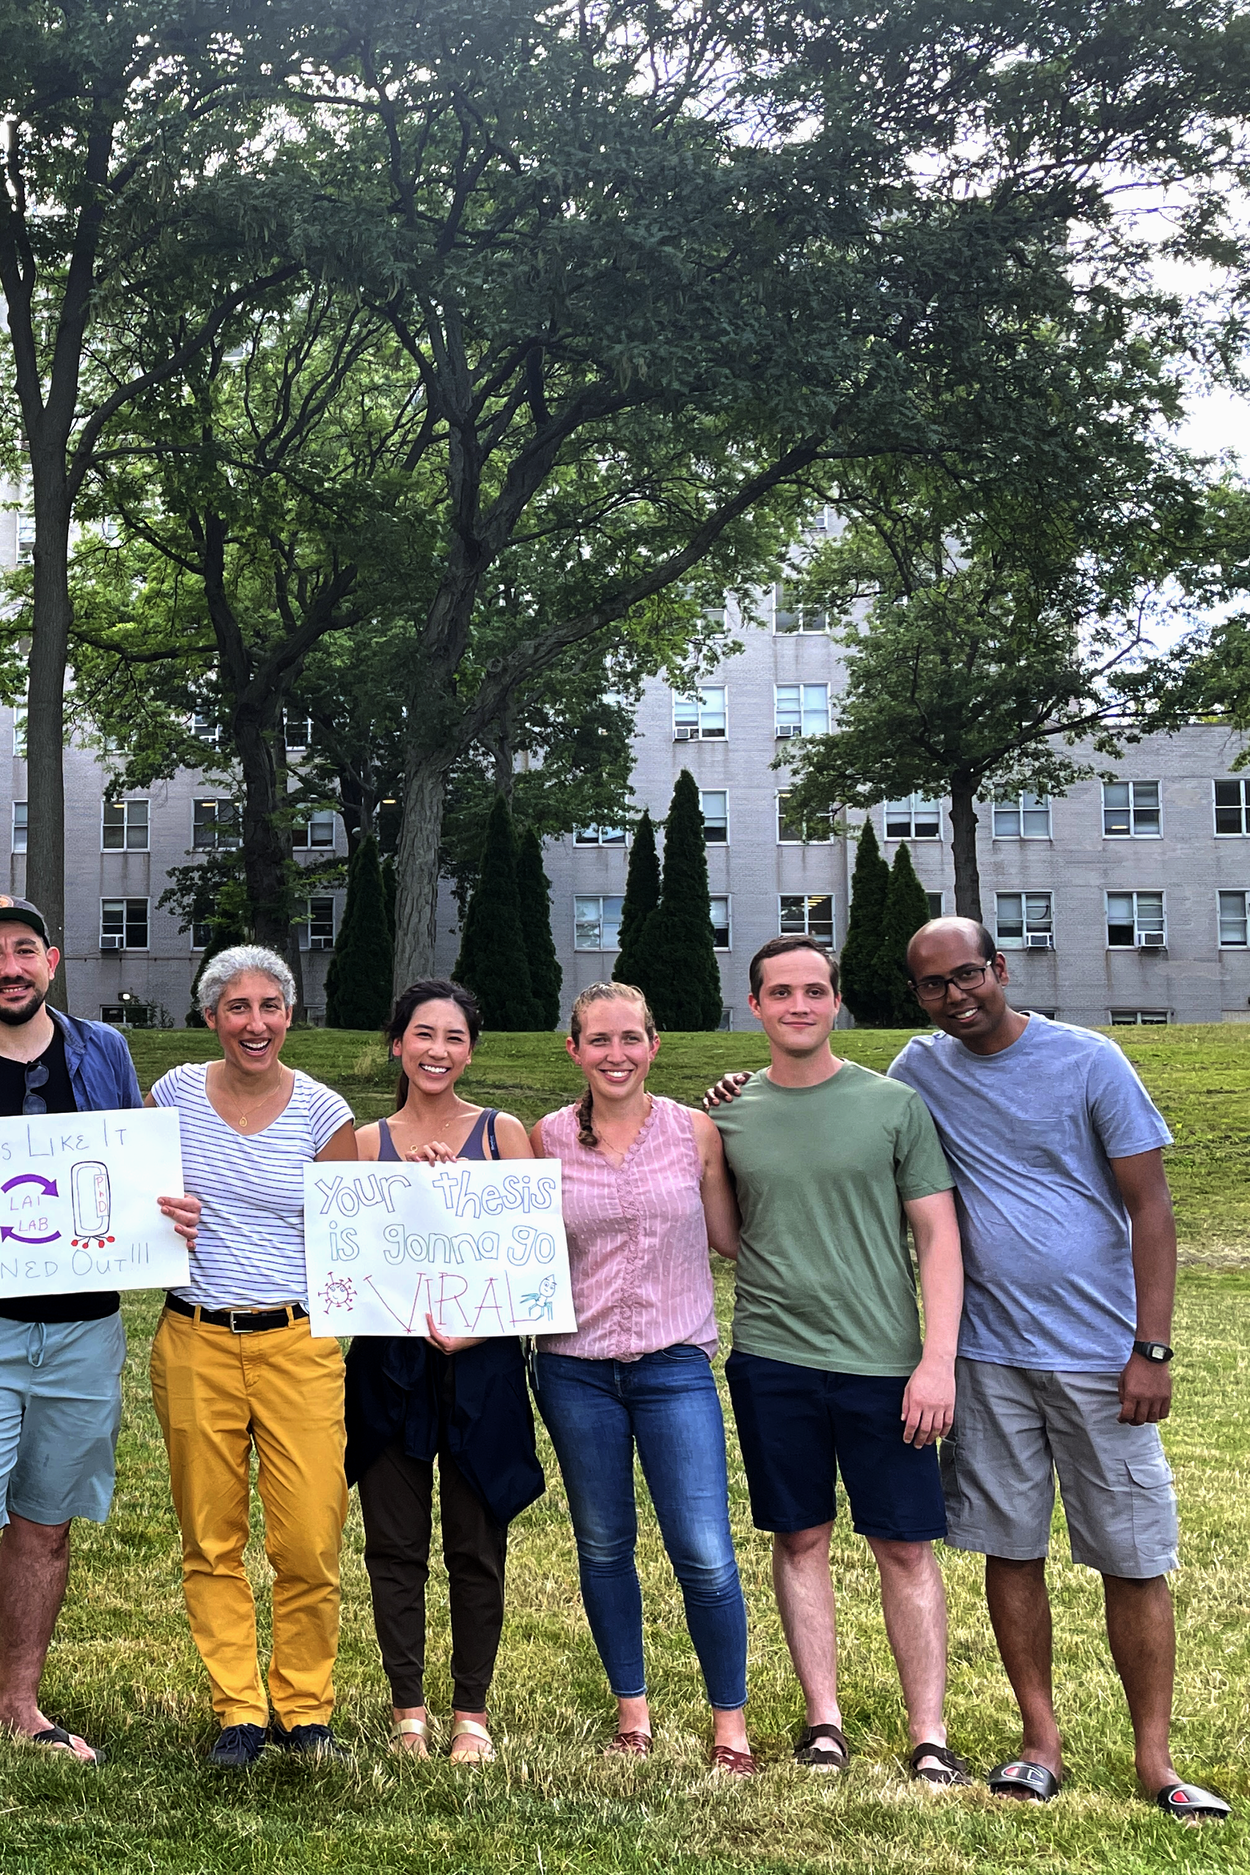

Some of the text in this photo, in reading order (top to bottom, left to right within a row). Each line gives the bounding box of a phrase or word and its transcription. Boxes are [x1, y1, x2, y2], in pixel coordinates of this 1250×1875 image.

[27, 1123, 90, 1157] LIKE
[102, 1118, 128, 1148] IT
[314, 1170, 557, 1219] Your thesis
[18, 1217, 50, 1232] LAB
[329, 1220, 556, 1267] is gonna go
[363, 1270, 538, 1333] VIRAL
